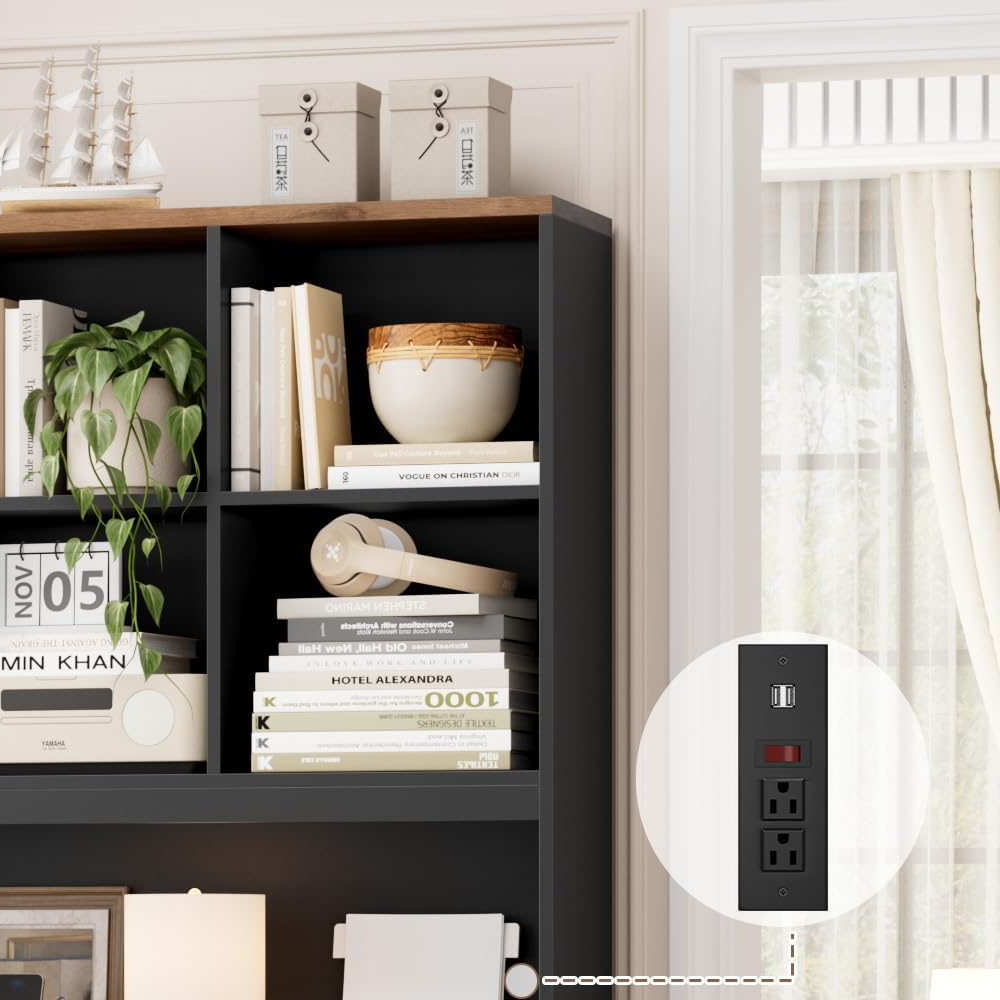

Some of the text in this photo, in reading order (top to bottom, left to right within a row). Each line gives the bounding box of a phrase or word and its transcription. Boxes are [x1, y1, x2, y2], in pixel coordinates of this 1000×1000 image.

[275, 133, 288, 141] TEA
[433, 472, 448, 480] ON
[450, 471, 499, 479] CHRISTIAN
[14, 565, 33, 618] NOV
[43, 570, 105, 612] 05
[41, 639, 58, 648] THE
[62, 638, 97, 647] AGAINST
[58, 654, 126, 670] KHAN
[331, 674, 454, 685] HOTEL ALEXANDRA
[264, 696, 276, 707] K
[425, 691, 499, 708] 1000
[257, 715, 270, 730] K
[417, 719, 497, 729] TEXTILE DESIGNERS
[41, 739, 65, 748] YAMAHA
[257, 738, 269, 749] K
[257, 755, 273, 771] K
